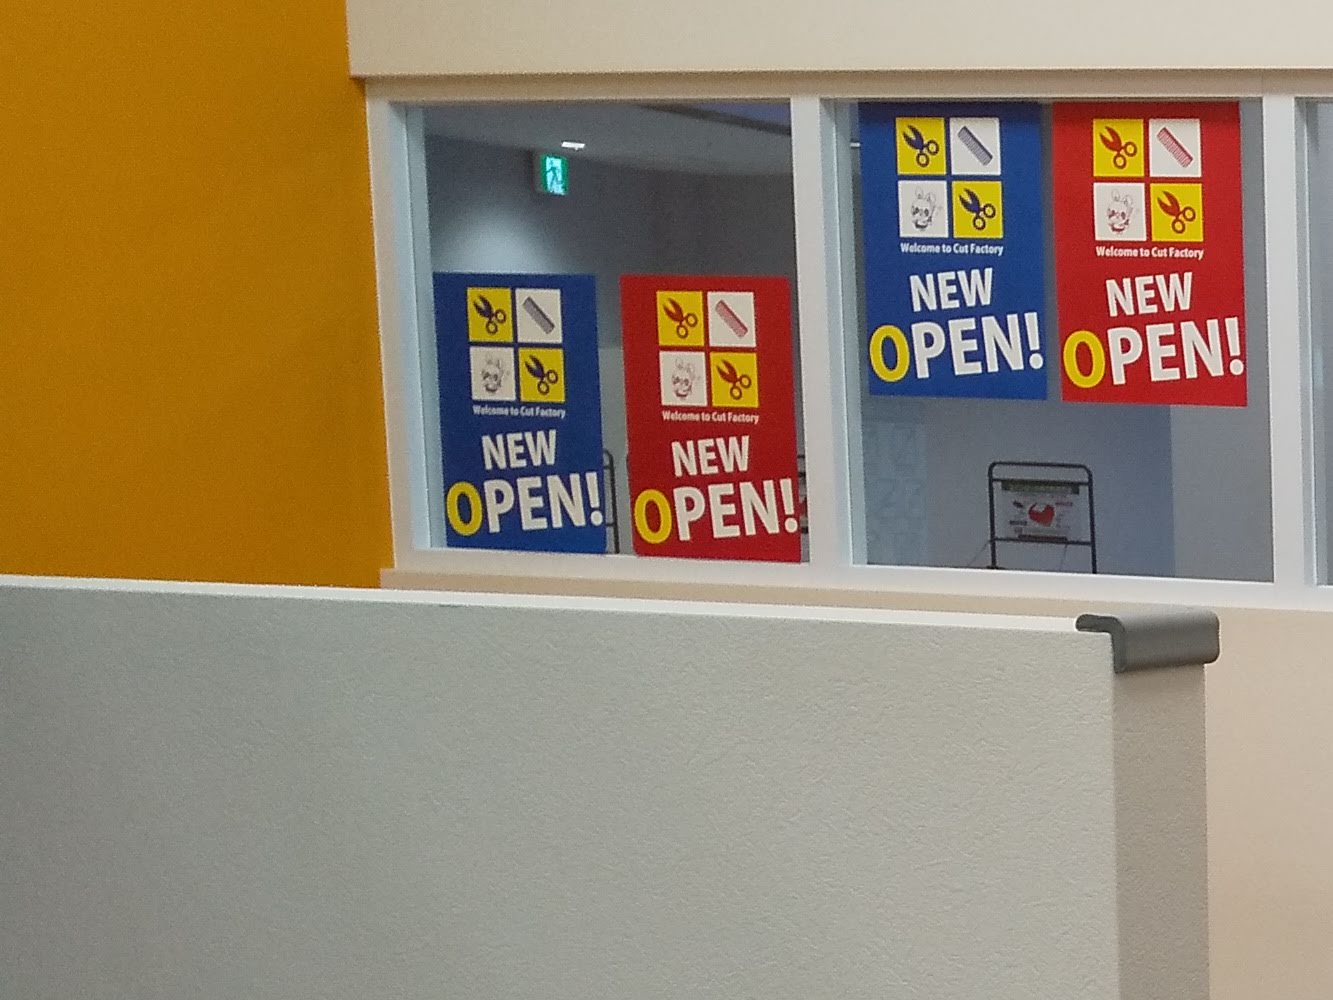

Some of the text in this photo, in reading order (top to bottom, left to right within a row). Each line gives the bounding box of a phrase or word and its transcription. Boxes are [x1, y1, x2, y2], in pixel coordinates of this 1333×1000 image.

[900, 242, 1003, 256] Welcome to Cut Factory
[1096, 247, 1204, 260] Welcome to Cut Factory
[909, 267, 993, 312] NEW
[1105, 271, 1193, 317] NEW
[869, 312, 1044, 383] OPEN!
[1063, 317, 1244, 388] OPEN!
[472, 404, 566, 419] Welcome to Cut Factory
[662, 410, 759, 424] Welcome to Cut Factory
[481, 429, 557, 470] NEW
[671, 435, 750, 477] NEW
[447, 472, 603, 536] OPEN!
[634, 478, 798, 544] OPEN!
